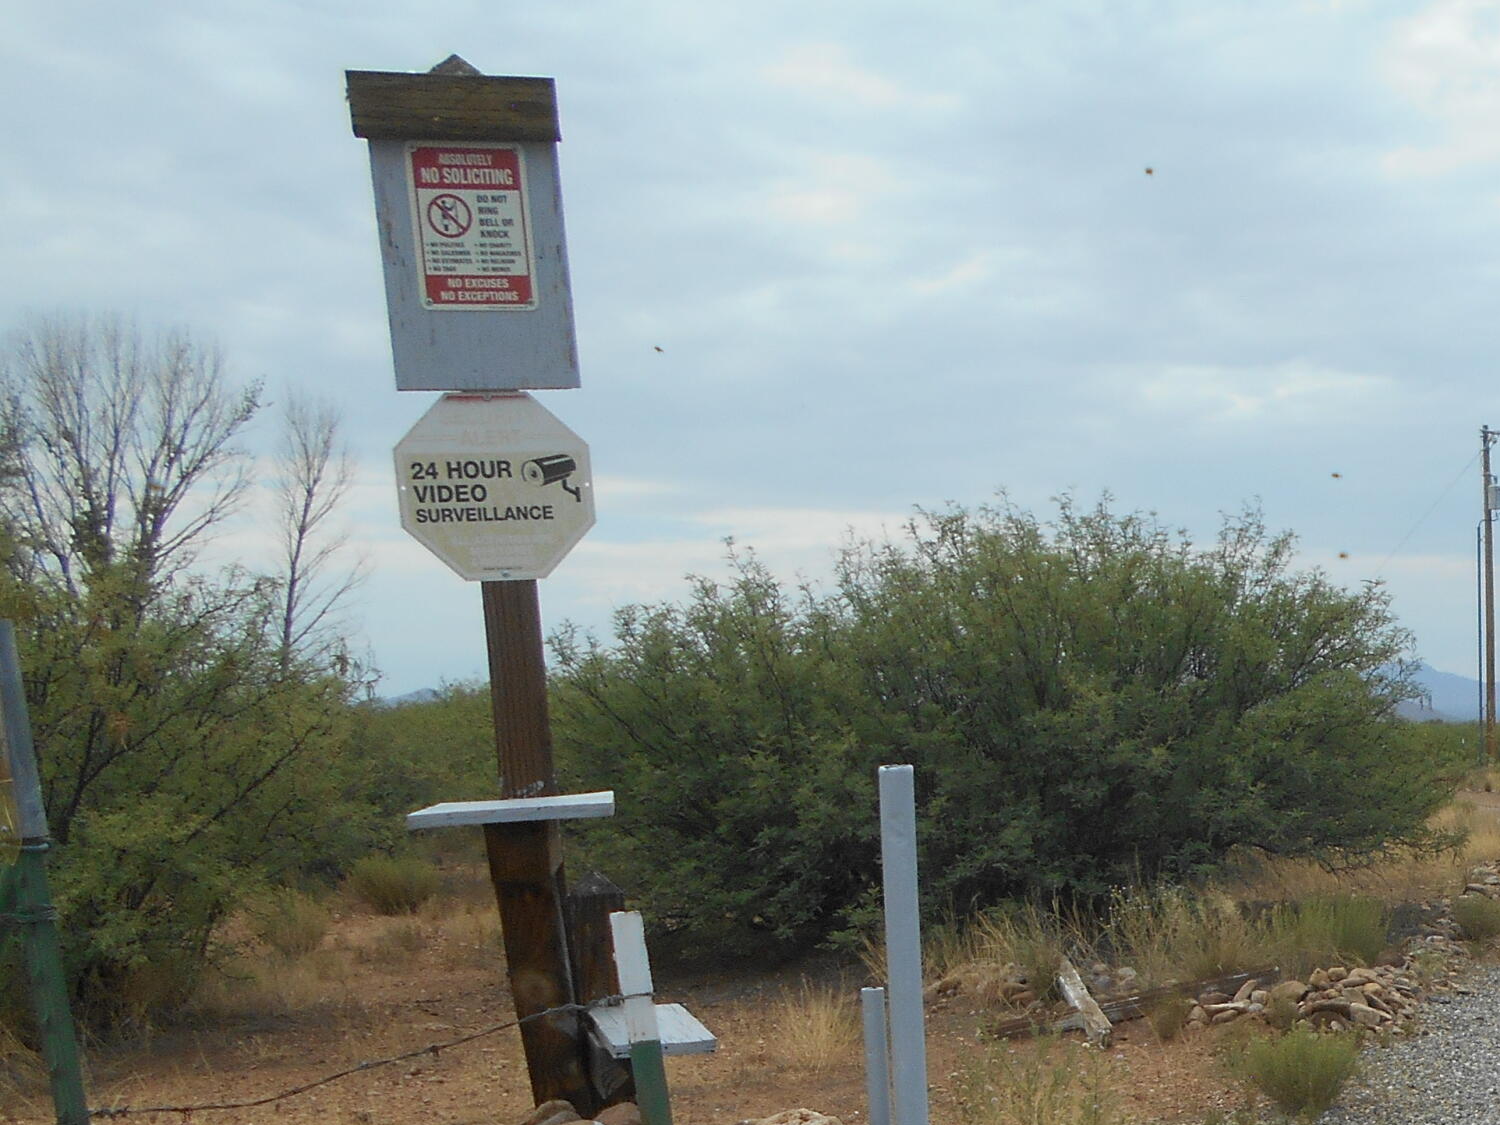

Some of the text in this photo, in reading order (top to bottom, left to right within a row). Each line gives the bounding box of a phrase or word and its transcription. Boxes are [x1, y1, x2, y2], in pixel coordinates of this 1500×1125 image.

[439, 153, 492, 166] ABSOLUTELY
[421, 167, 514, 185] NO SOLICITING
[476, 195, 507, 203] DO NOT
[478, 207, 499, 215] RING
[479, 218, 514, 226] BELL OR
[480, 229, 510, 239] KNOCK
[447, 278, 509, 288] NO EXCUSES
[441, 291, 519, 301] NO EXCEPTIONS
[411, 460, 513, 480] 24 HOUR
[413, 484, 487, 503] VIDEO
[416, 505, 554, 523] SURVEILLANCE
